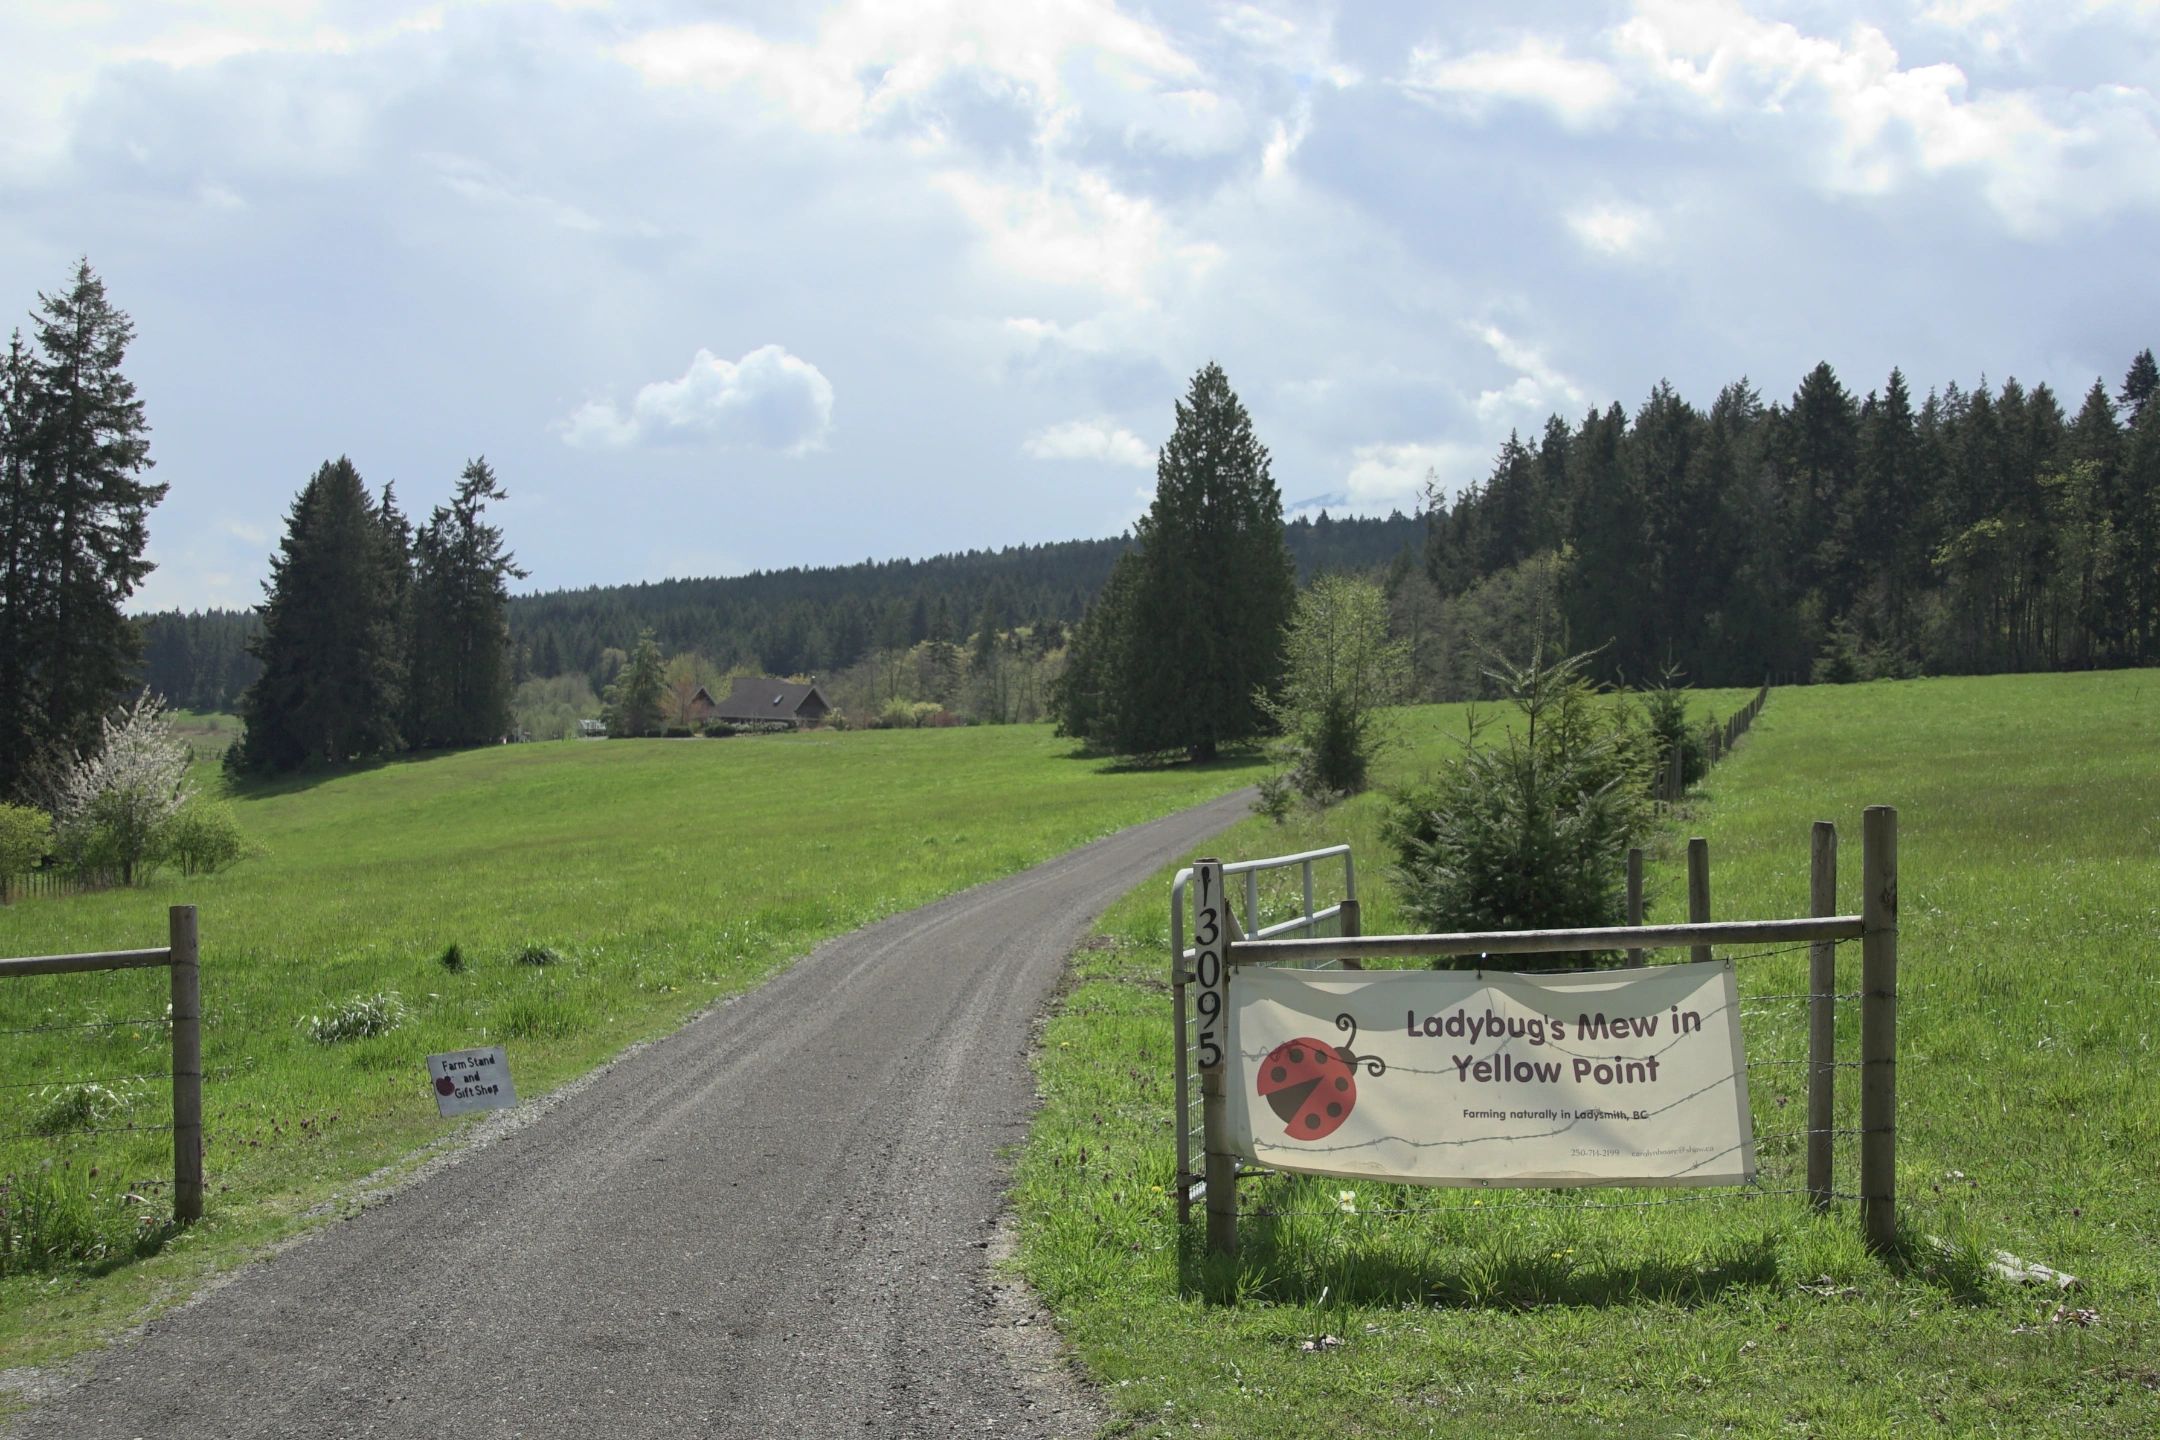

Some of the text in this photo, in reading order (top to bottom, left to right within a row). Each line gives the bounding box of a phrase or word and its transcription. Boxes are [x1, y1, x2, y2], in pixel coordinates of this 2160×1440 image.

[1195, 866, 1221, 1068] 13095
[1407, 1005, 1701, 1045] Ladybug's Mew in
[442, 1054, 495, 1072] Farm Stand
[1452, 1053, 1660, 1085] Yellow Point
[463, 1071, 480, 1083] and
[454, 1084, 499, 1099] Gift Shop
[1463, 1109, 1648, 1121] Farming naturally in Ladysmith, BC
